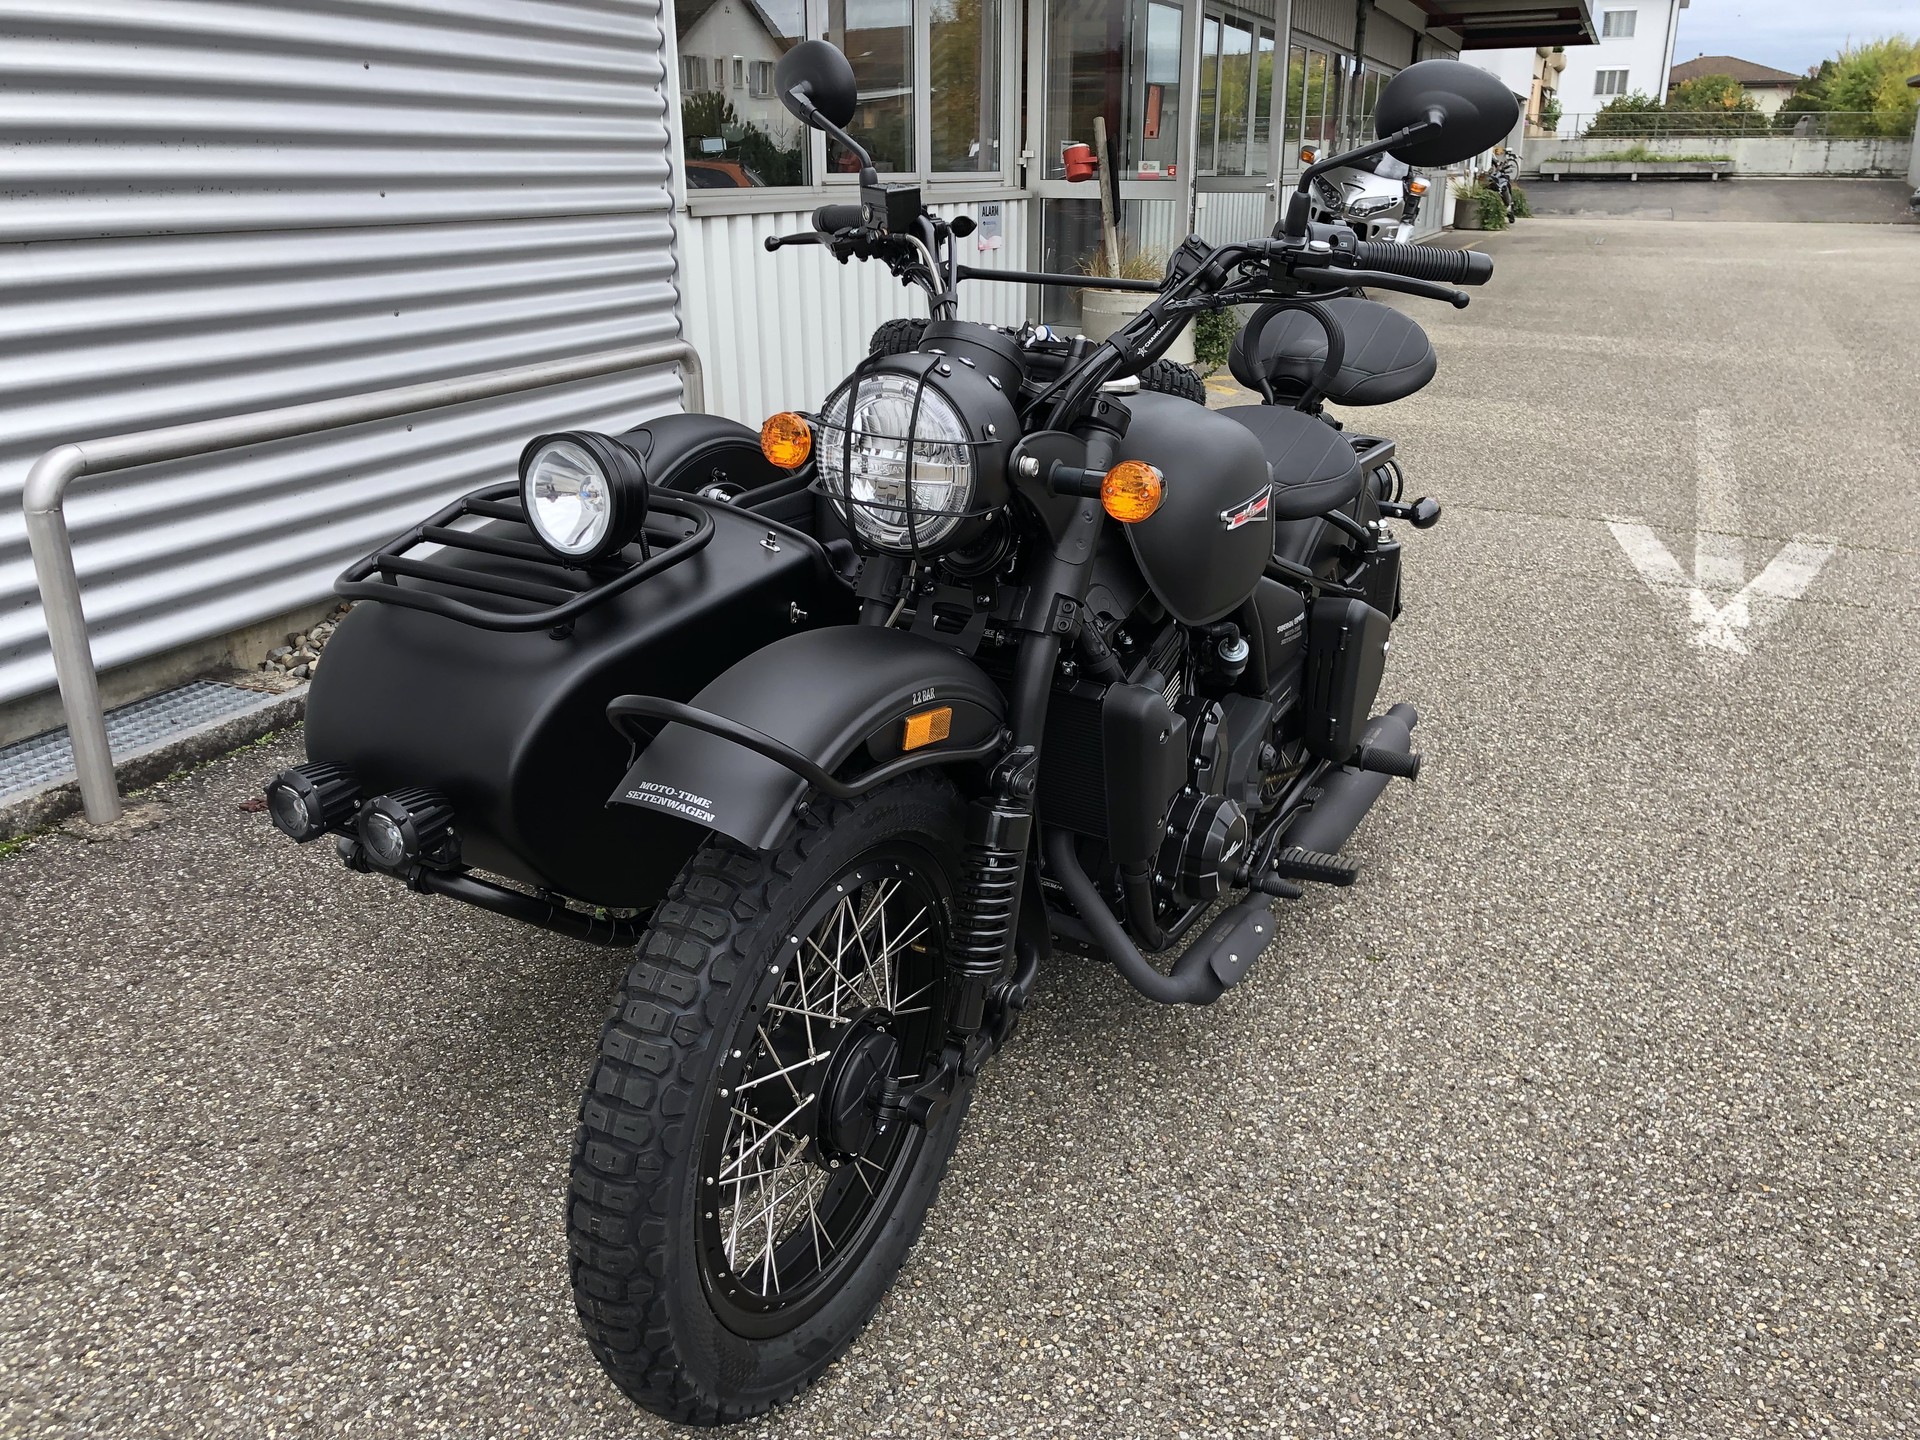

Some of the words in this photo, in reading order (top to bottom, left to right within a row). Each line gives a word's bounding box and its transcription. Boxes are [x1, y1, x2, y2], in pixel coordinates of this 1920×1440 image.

[981, 205, 999, 217] ALARM
[912, 691, 922, 705] 2.2
[922, 687, 936, 702] BAR
[625, 790, 716, 823] SEITENWAGEN
[638, 781, 713, 809] MOTO-TIME
